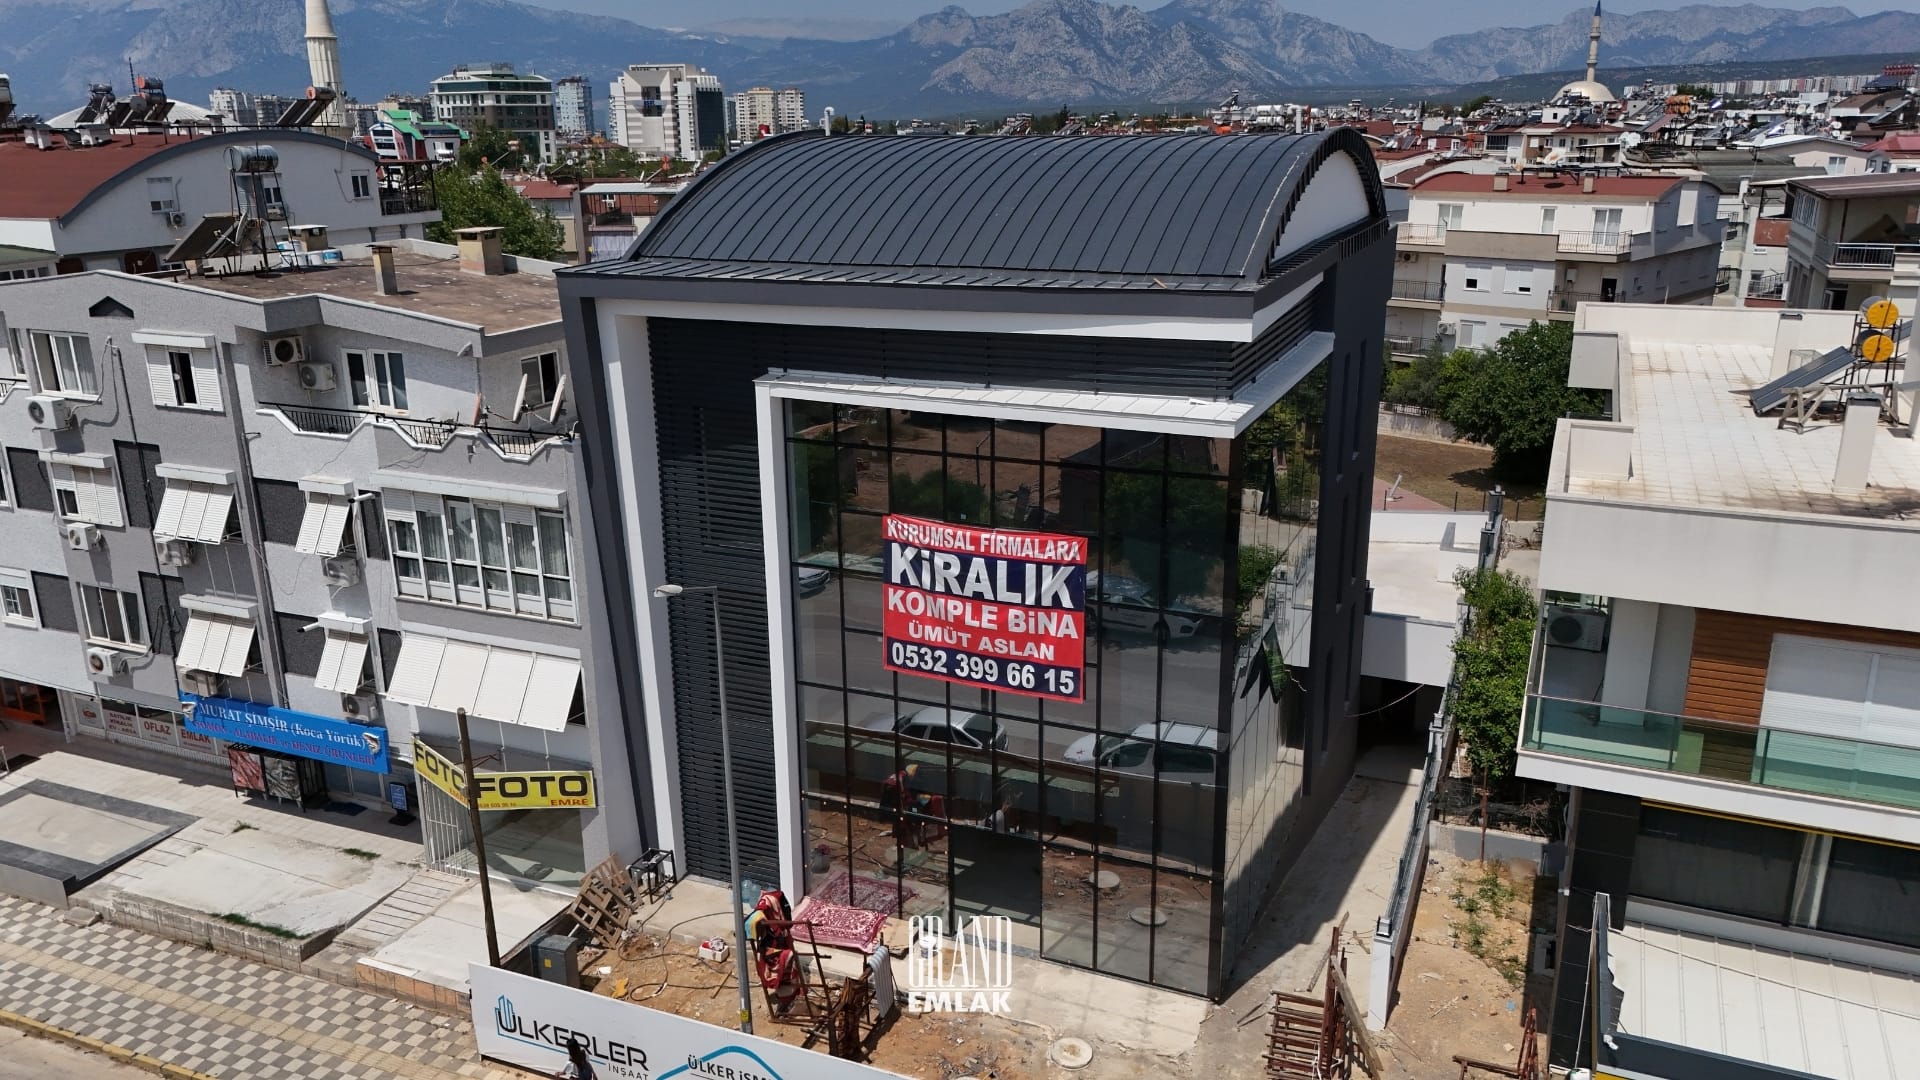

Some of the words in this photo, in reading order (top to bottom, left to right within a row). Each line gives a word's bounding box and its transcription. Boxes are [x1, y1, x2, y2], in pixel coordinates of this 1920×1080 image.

[887, 519, 975, 551] KURUMSAL
[980, 532, 1081, 561] FİRMALARA
[888, 588, 998, 630] KOMPLE
[908, 620, 972, 648] ÜMÜT
[978, 636, 1055, 661] ASLAN
[892, 642, 948, 674] 0532
[955, 653, 999, 682] 399
[1006, 663, 1036, 689] 66
[1044, 668, 1075, 694] 15
[143, 720, 171, 735] OFLAZ
[200, 703, 242, 722] MURAT
[245, 711, 289, 733] ŞİMŞİR
[181, 728, 211, 744] EMLAK
[414, 743, 465, 791] FOTO
[475, 775, 588, 799] FOTO
[550, 798, 590, 807] EMRE
[687, 1054, 736, 1080] ÜLKER
